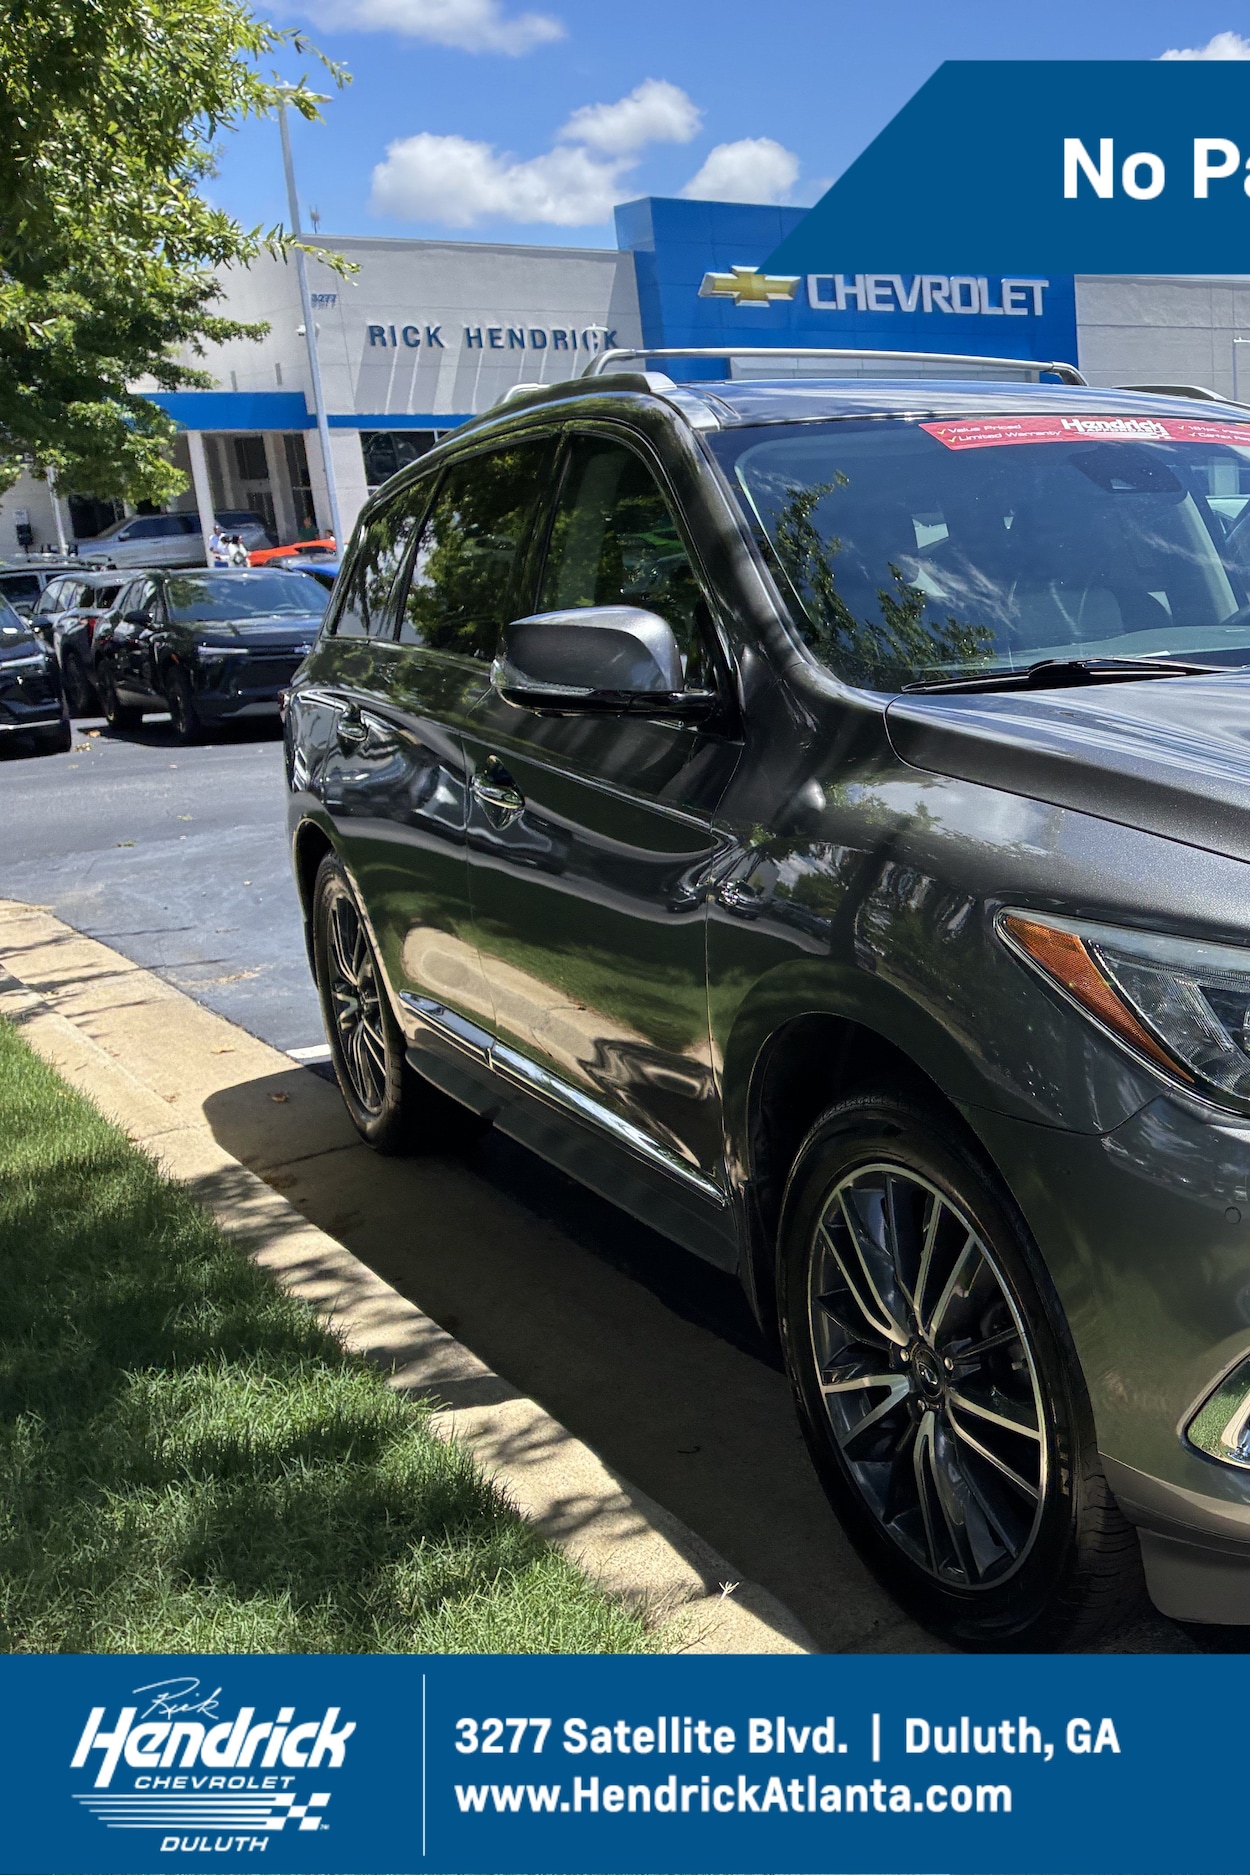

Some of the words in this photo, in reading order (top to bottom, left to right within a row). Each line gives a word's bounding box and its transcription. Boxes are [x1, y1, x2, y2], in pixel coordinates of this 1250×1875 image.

[806, 274, 1050, 316] CHEVROLET
[367, 325, 444, 349] RICK
[466, 326, 619, 351] HENDRICK
[1060, 419, 1168, 433] Hendrick
